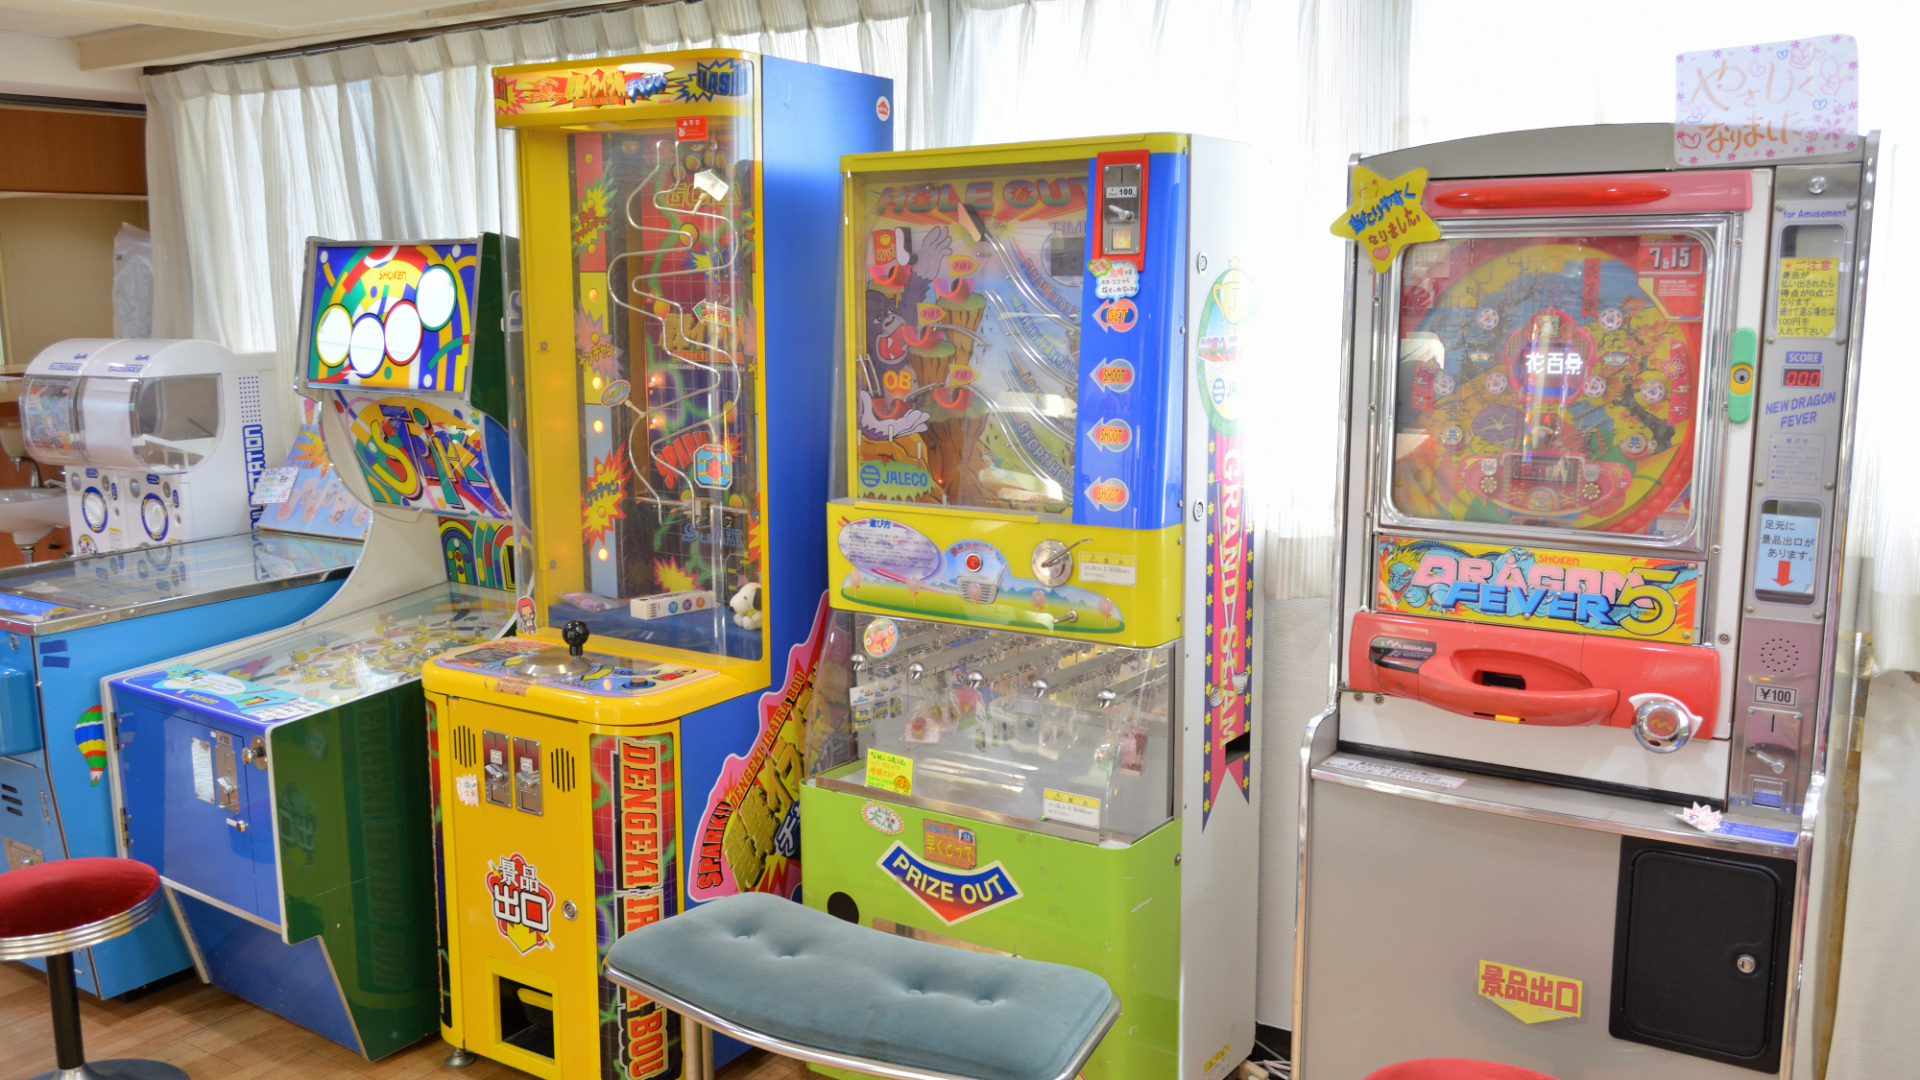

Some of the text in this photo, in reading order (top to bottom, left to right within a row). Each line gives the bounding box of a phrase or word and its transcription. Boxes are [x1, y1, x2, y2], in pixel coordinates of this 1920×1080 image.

[1689, 59, 1814, 112] やさしく
[1698, 110, 1805, 153] なりました
[876, 182, 995, 215] HOLE
[1119, 188, 1133, 196] 100
[1348, 182, 1416, 235] 当たりやすく
[1783, 209, 1847, 219] for Amusement
[1050, 221, 1087, 237] TIM
[954, 262, 967, 271] PAR
[1795, 260, 1833, 271] ご注意
[1782, 271, 1810, 279] 景品が
[1021, 258, 1080, 321] FINAL HOLE
[1780, 280, 1836, 289] 払い出されたら
[922, 310, 934, 318] PAR
[1106, 308, 1129, 323] GET
[1778, 317, 1810, 326] 100円を
[1788, 353, 1820, 363] SCORE
[882, 369, 914, 391] OB
[954, 371, 967, 380] PAR
[1103, 369, 1126, 382] SHOOT
[1785, 371, 1821, 387] 000
[1765, 391, 1837, 415] NEW DRAGON
[1780, 411, 1818, 428] FEVER
[1018, 421, 1050, 465] SHORT
[1100, 428, 1123, 442] SHOOT
[882, 470, 928, 487] JALECO
[1097, 487, 1120, 502] SHOOT
[1221, 447, 1241, 606] GRAND
[1764, 519, 1796, 531] 足元に
[1761, 534, 1815, 547] 景品出口が
[1537, 553, 1580, 567] SHOKEN
[1766, 548, 1813, 562] あります。
[1441, 580, 1622, 626] FEVER
[1402, 644, 1433, 653] NISHIJIN
[1217, 623, 1239, 750] SLAM
[1759, 687, 1792, 703] ¥100
[729, 671, 806, 810] DENGEKI IRAIRA BOU
[621, 739, 659, 889] DENGEKI
[925, 822, 969, 838] お知らせ
[697, 801, 733, 889] SPARK!!
[926, 834, 973, 862] 早くとって
[498, 856, 540, 893] 景品
[892, 853, 1005, 905] PRIZE OUT
[493, 883, 550, 933] 出口
[1481, 964, 1579, 1014] 景品出口
